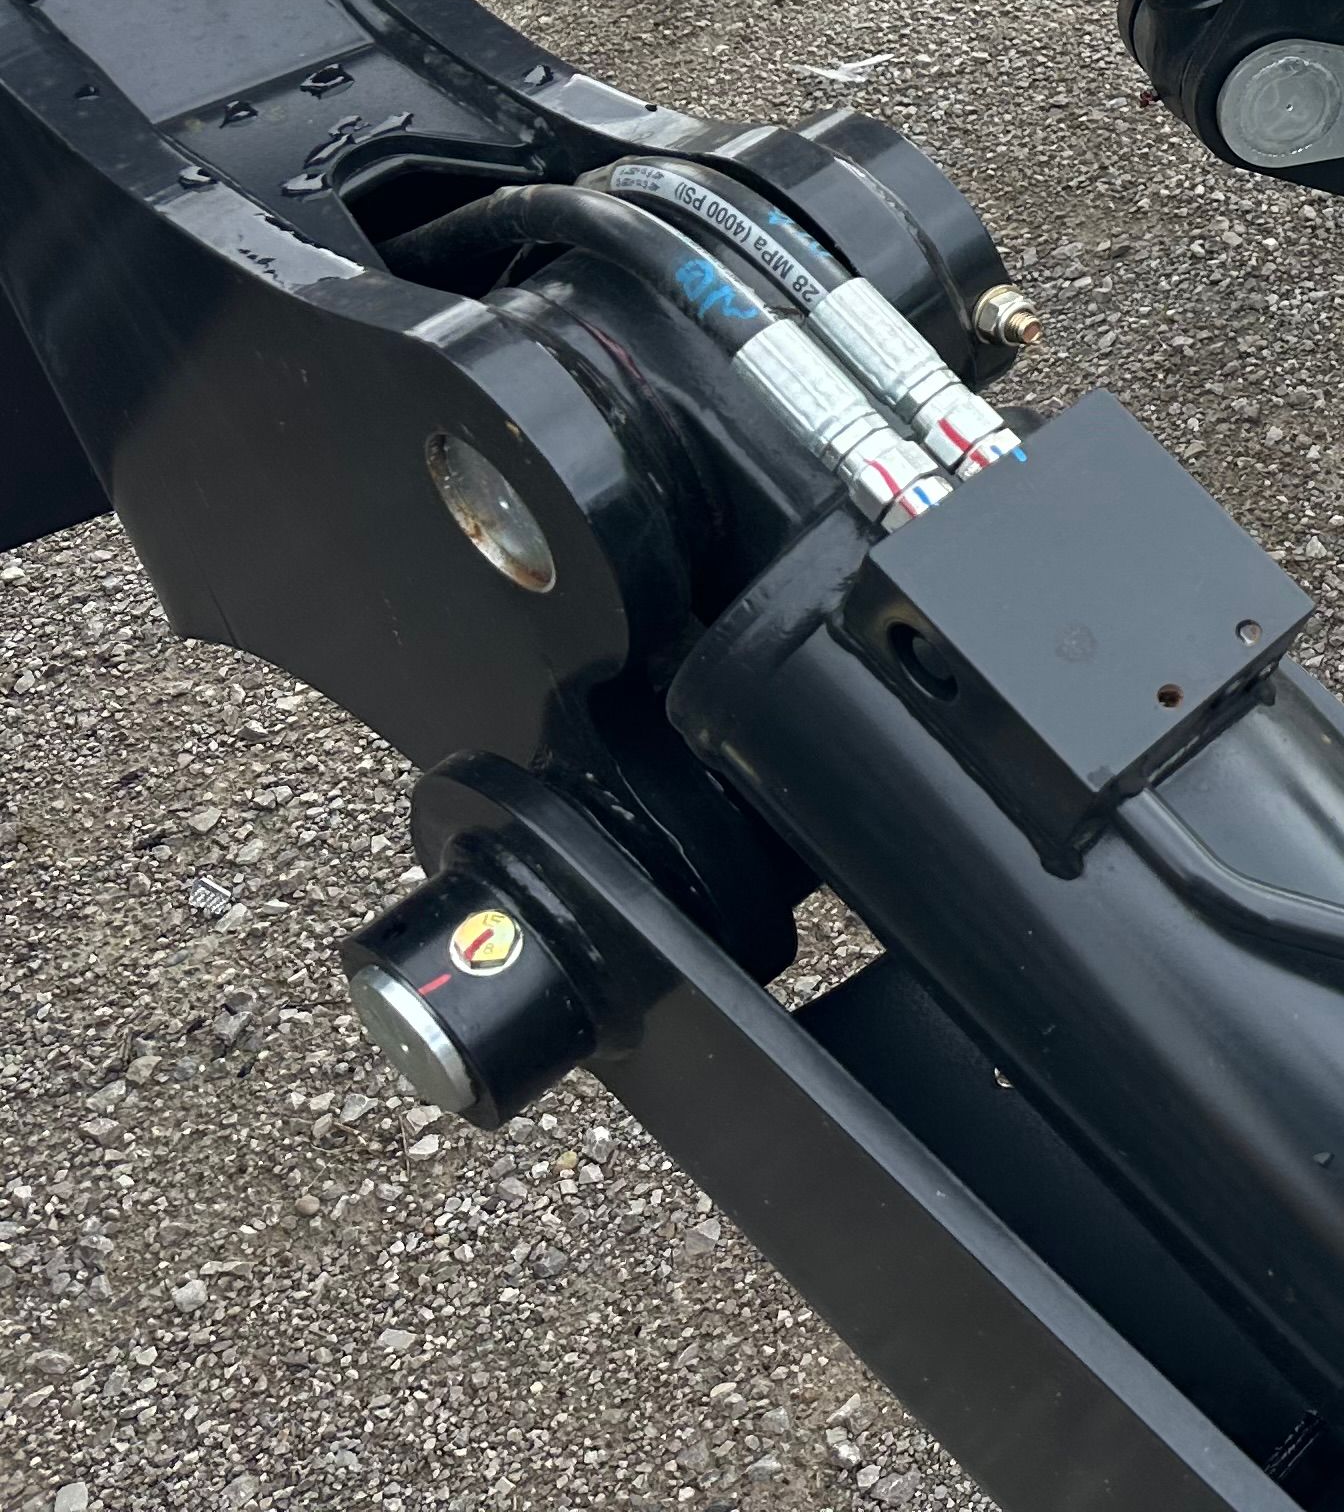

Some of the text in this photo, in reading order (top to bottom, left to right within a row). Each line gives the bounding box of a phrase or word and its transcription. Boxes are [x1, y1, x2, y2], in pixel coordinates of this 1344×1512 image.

[674, 181, 707, 211] PSI)
[706, 201, 752, 243] (4000
[754, 236, 794, 280] MPa
[793, 275, 820, 302] 28
